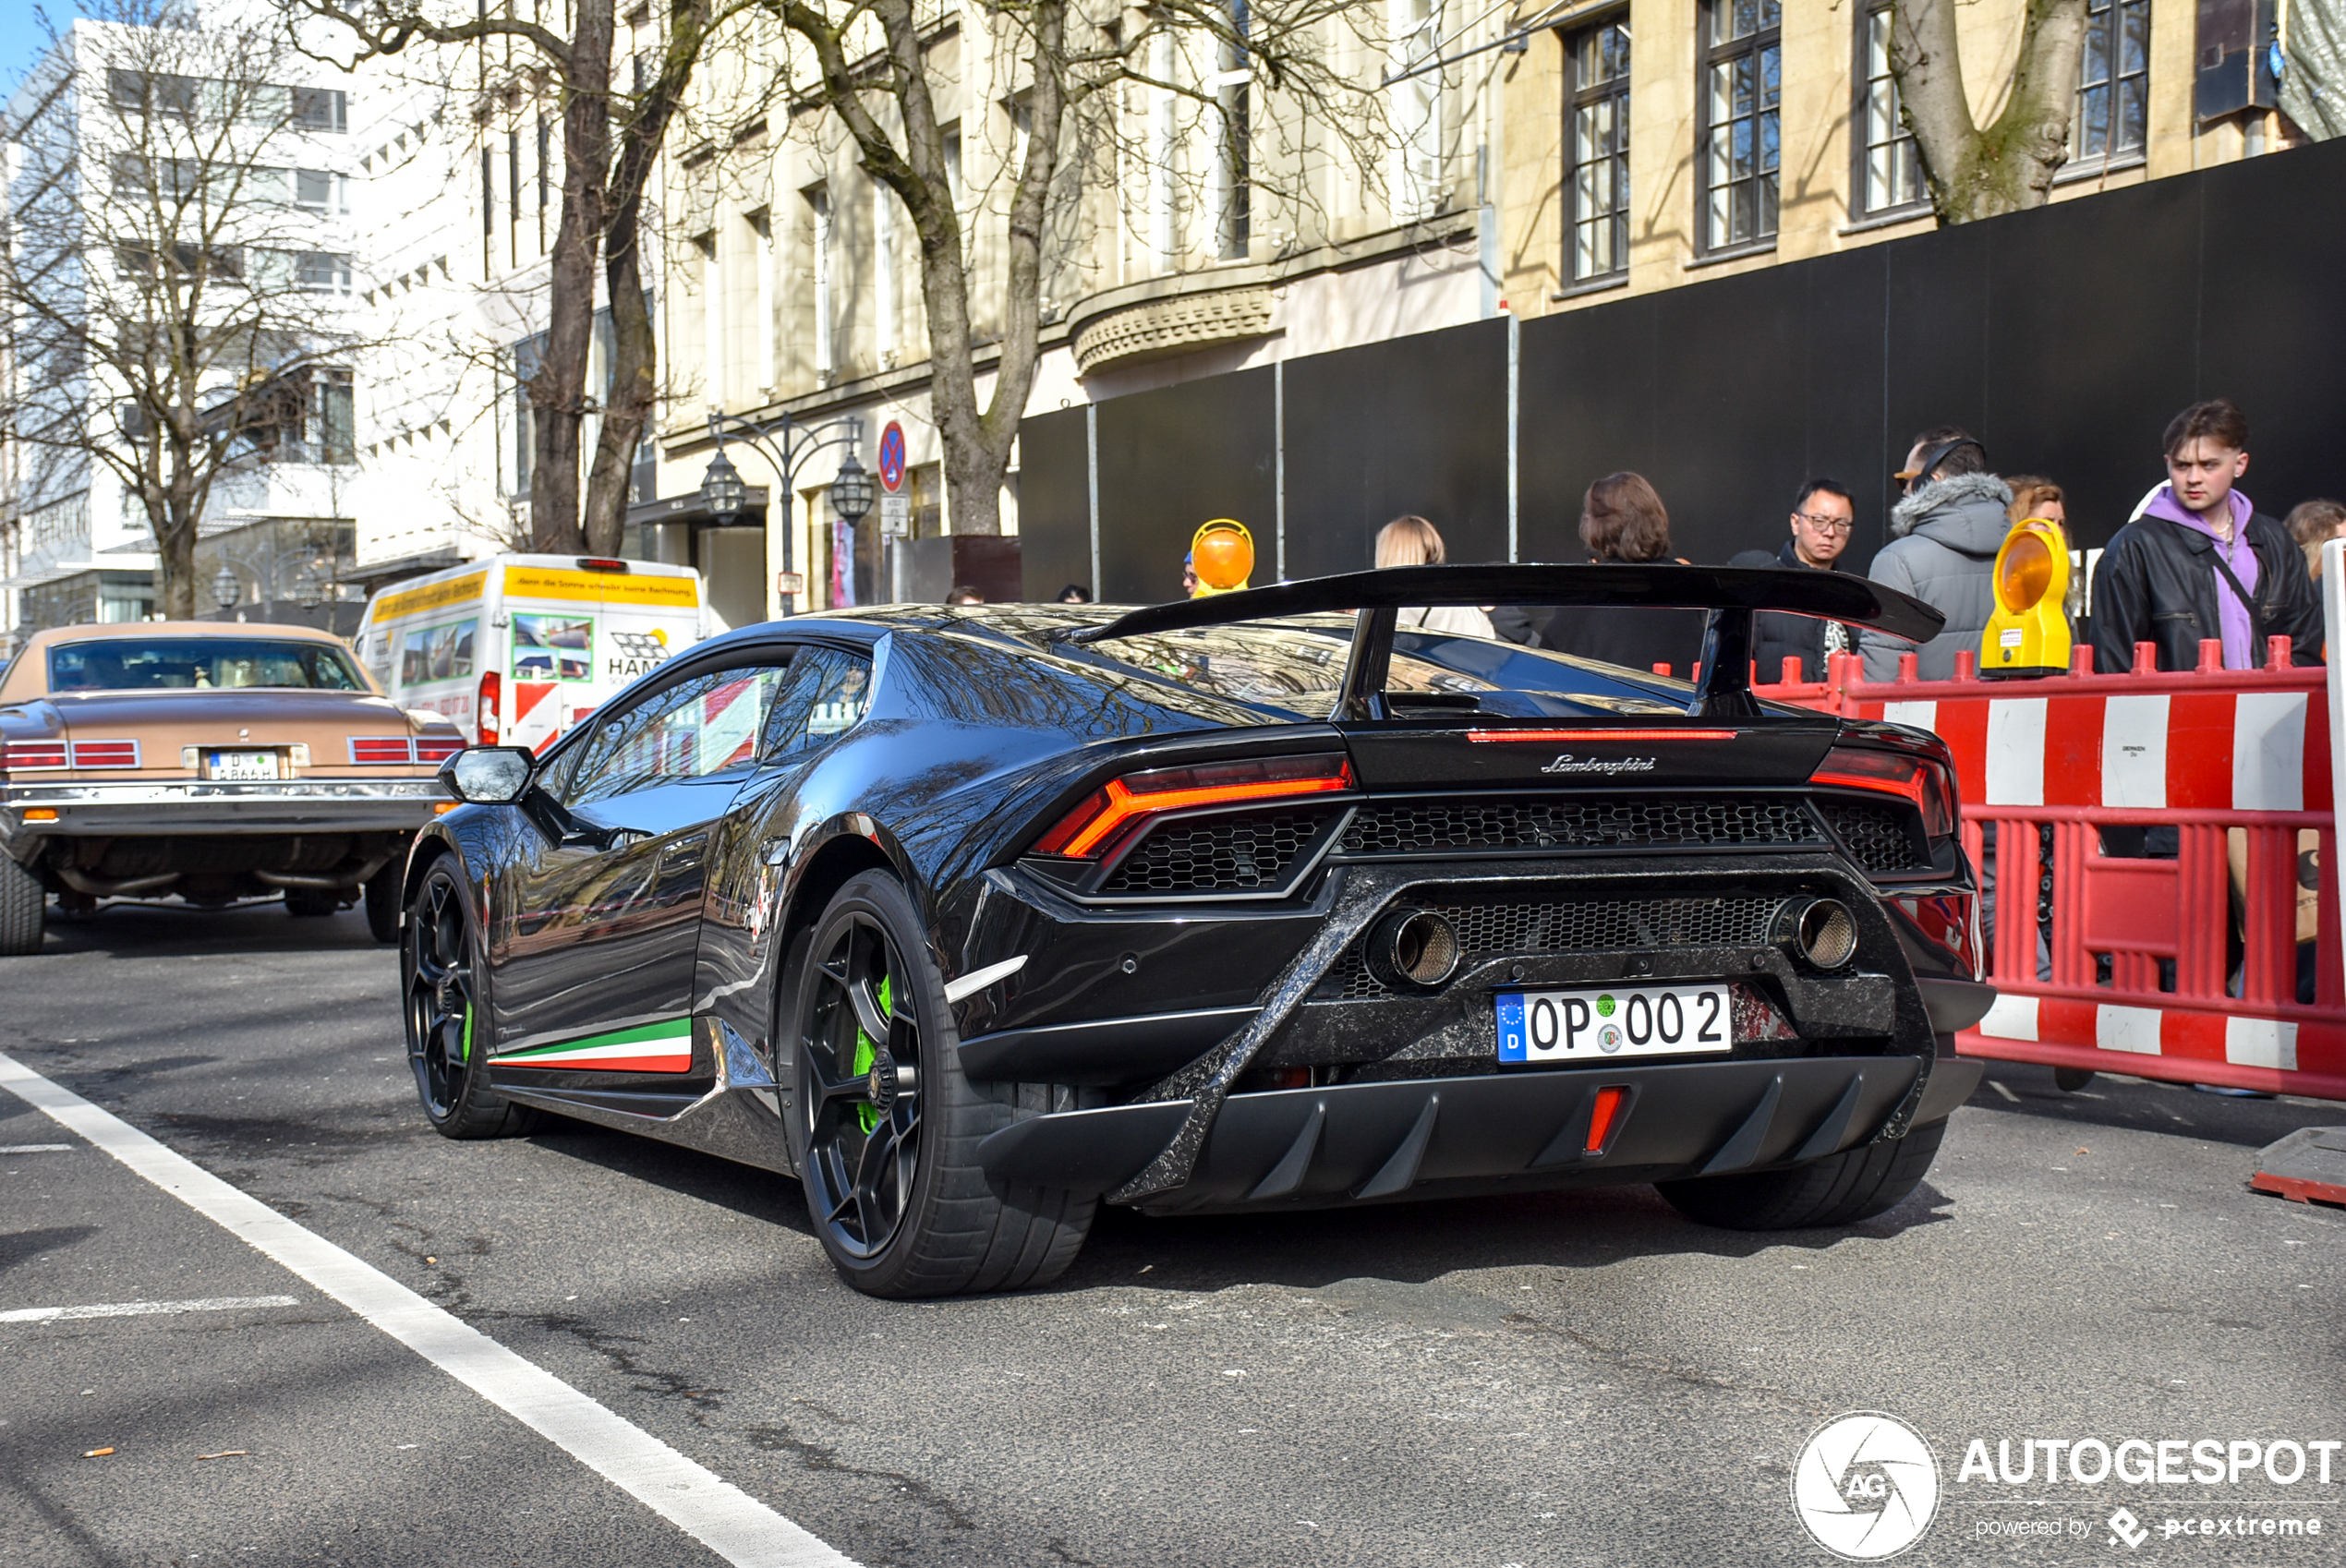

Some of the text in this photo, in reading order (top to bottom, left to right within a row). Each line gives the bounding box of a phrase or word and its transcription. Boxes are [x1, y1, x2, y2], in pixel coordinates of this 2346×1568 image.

[1541, 754, 1657, 776] Lamborghini
[1530, 997, 1590, 1051] OP
[1506, 1033, 1519, 1049] D
